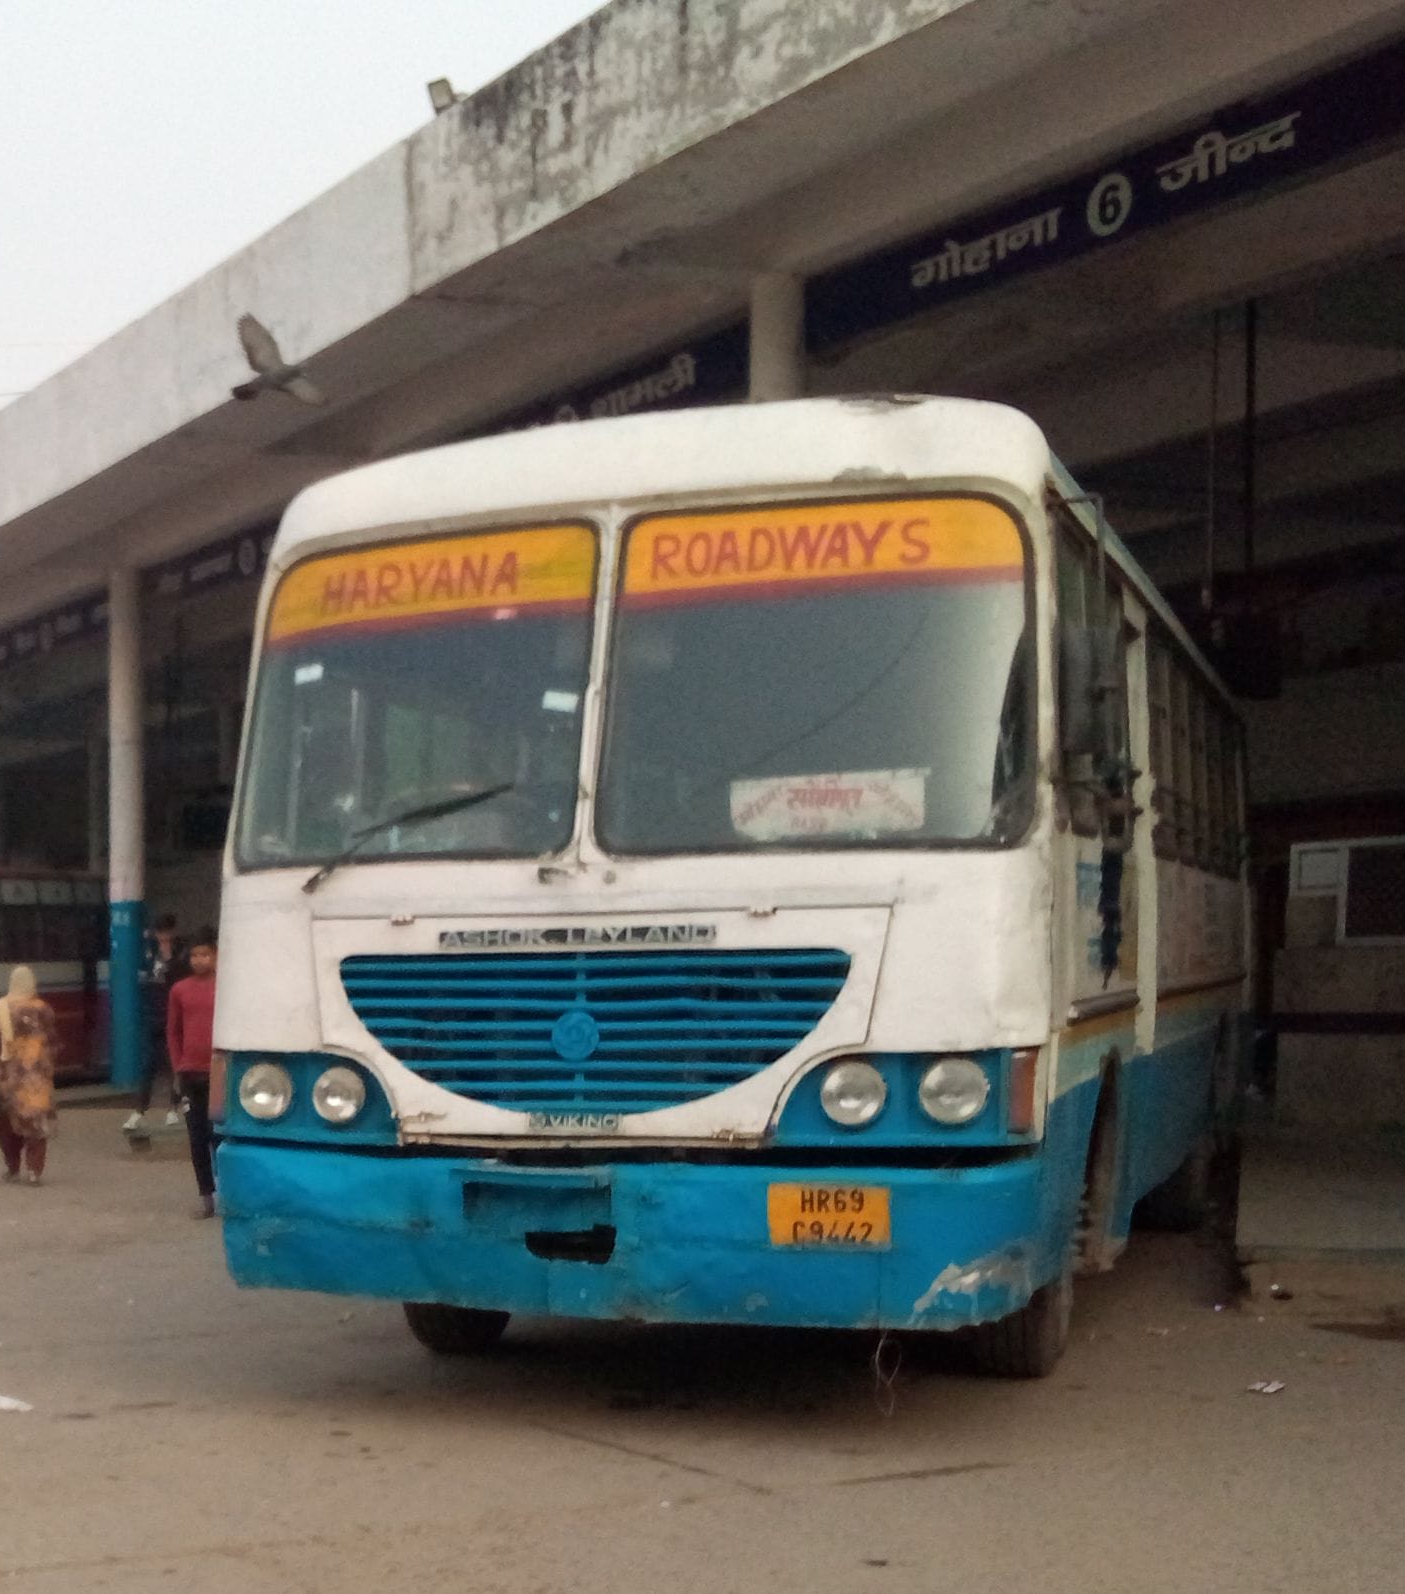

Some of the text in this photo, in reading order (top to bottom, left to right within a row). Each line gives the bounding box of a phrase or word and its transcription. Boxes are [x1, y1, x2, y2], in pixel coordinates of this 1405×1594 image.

[910, 207, 1062, 287] गोहाना
[1154, 110, 1302, 192] जीन्द
[321, 551, 518, 616] HARYANA
[651, 517, 932, 580] ROADWAYS
[443, 929, 543, 946] ASHOK
[800, 1188, 865, 1213] HR69
